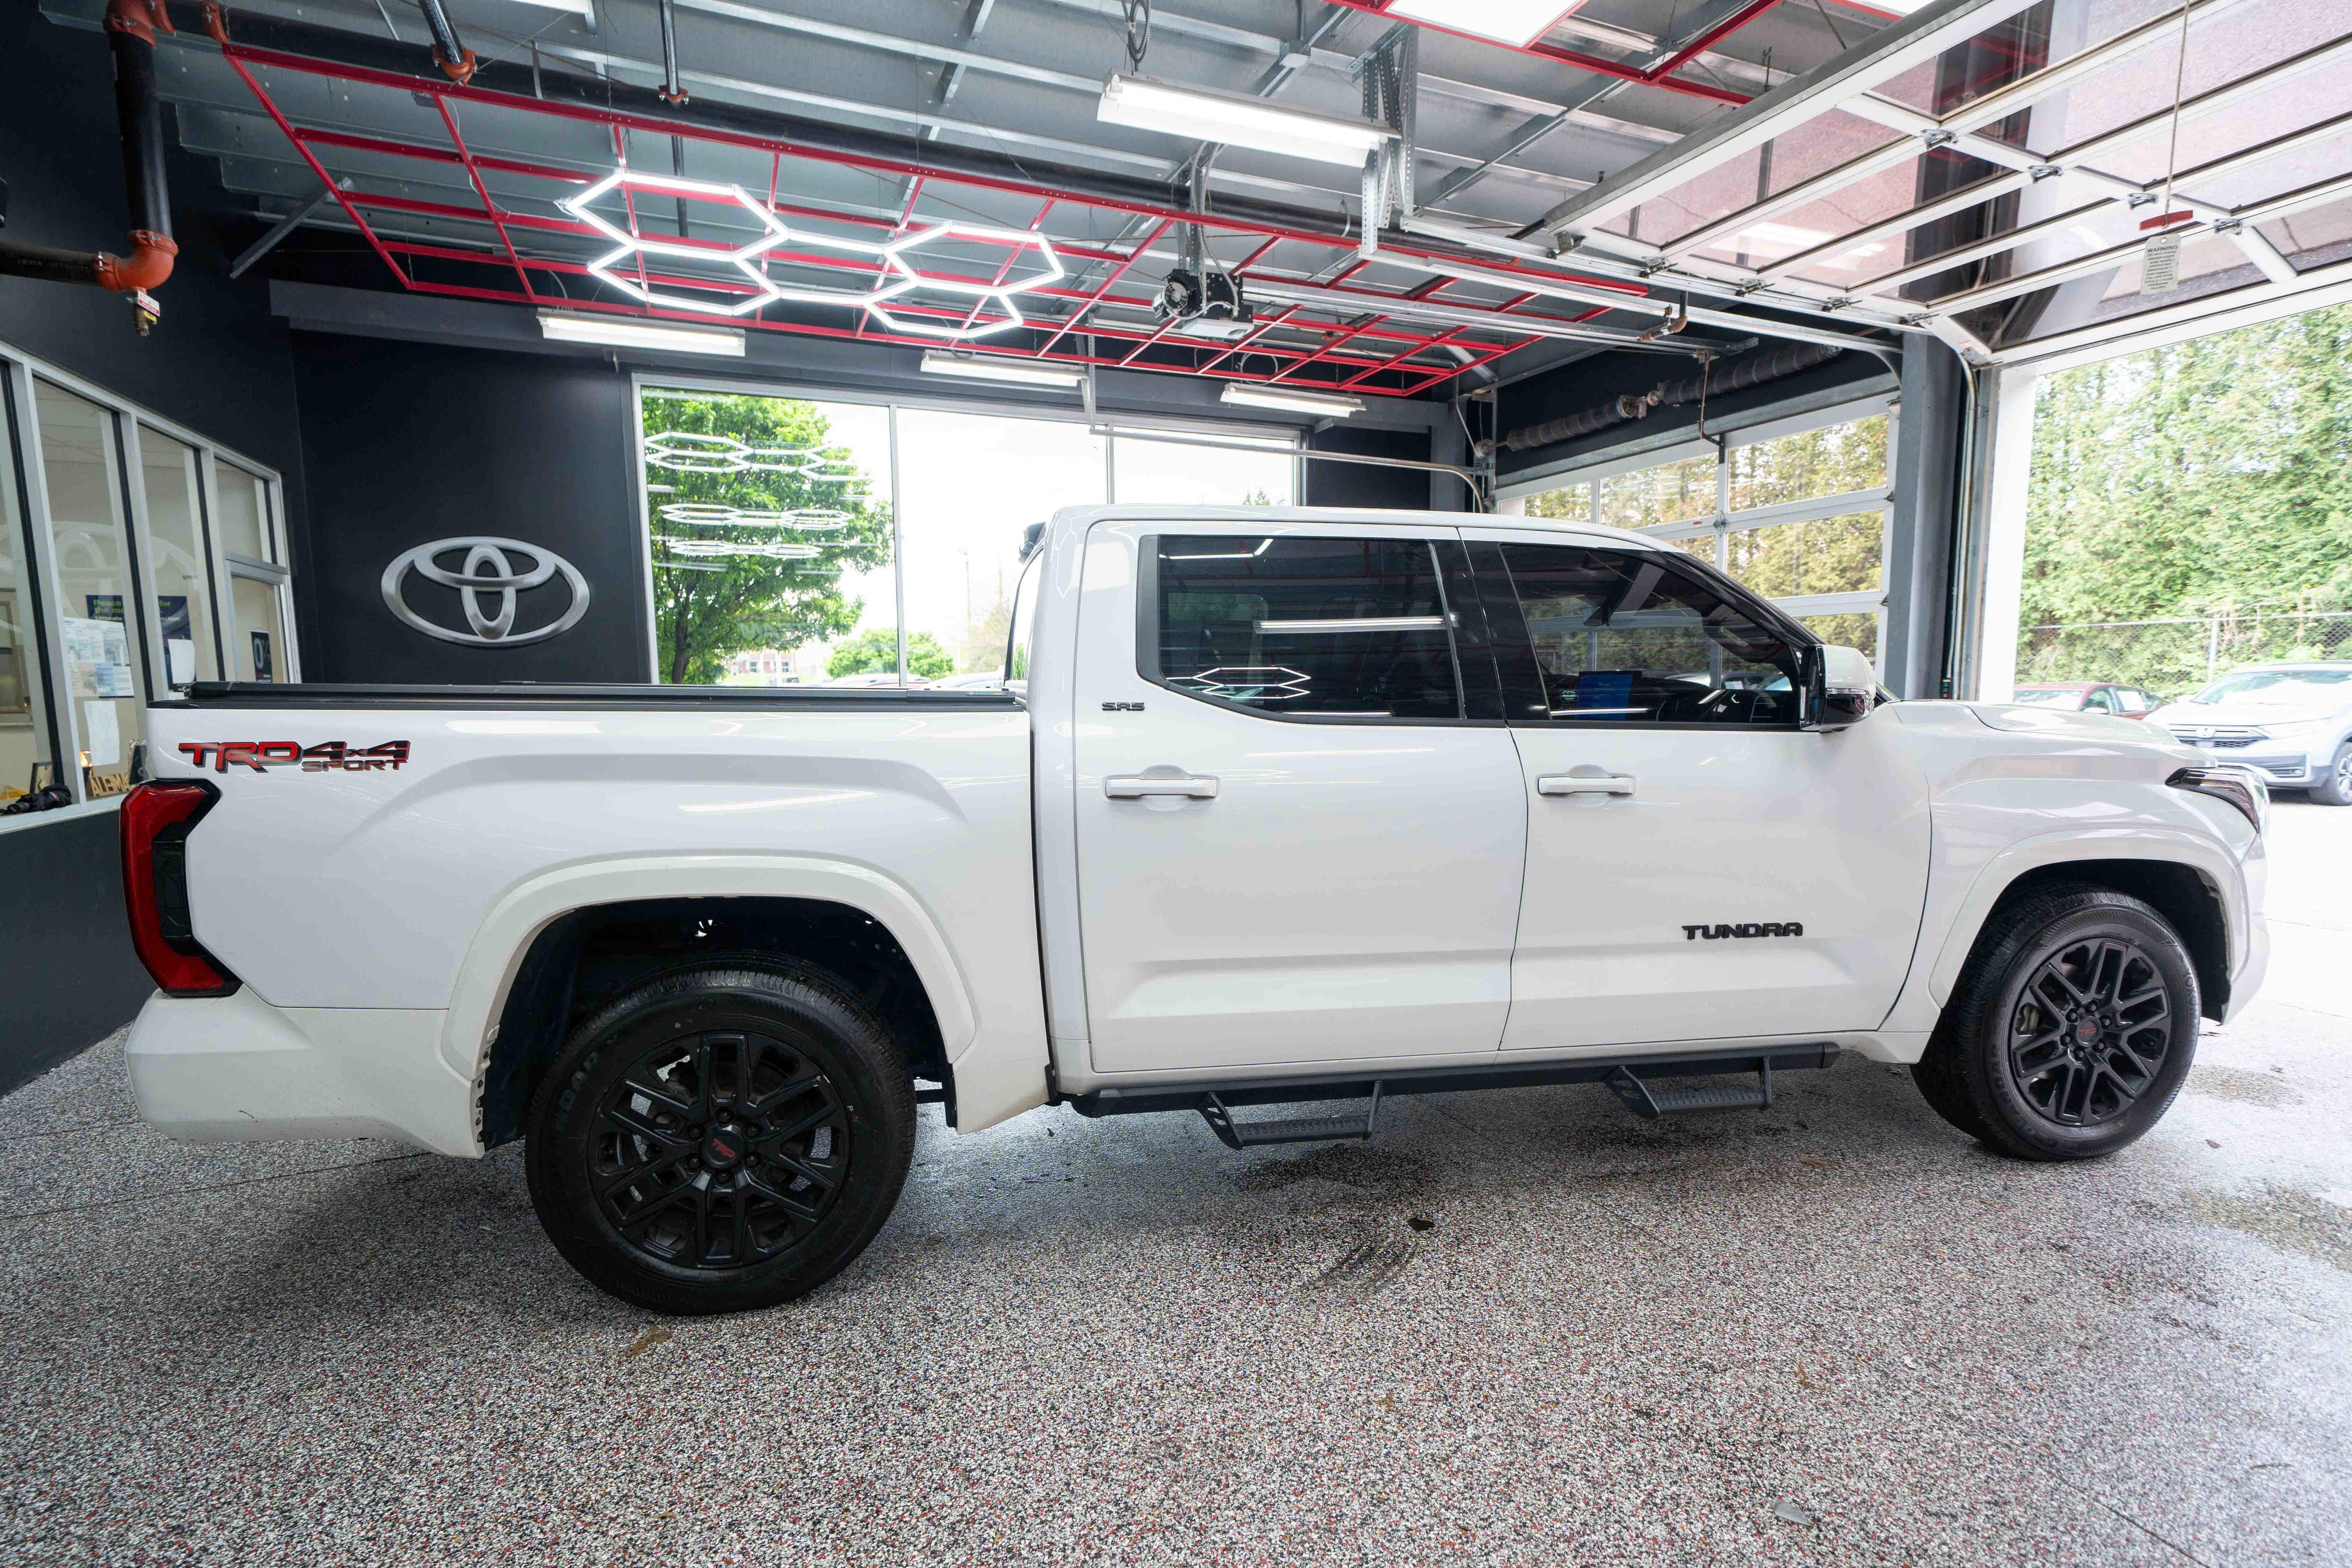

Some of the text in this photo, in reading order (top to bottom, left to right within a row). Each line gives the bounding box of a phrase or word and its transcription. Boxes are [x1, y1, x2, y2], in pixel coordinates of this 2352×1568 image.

[1102, 702, 1145, 711] SR5
[178, 741, 303, 774] TRD
[301, 759, 408, 773] SPORT
[1682, 922, 1803, 940] TUNDRA
